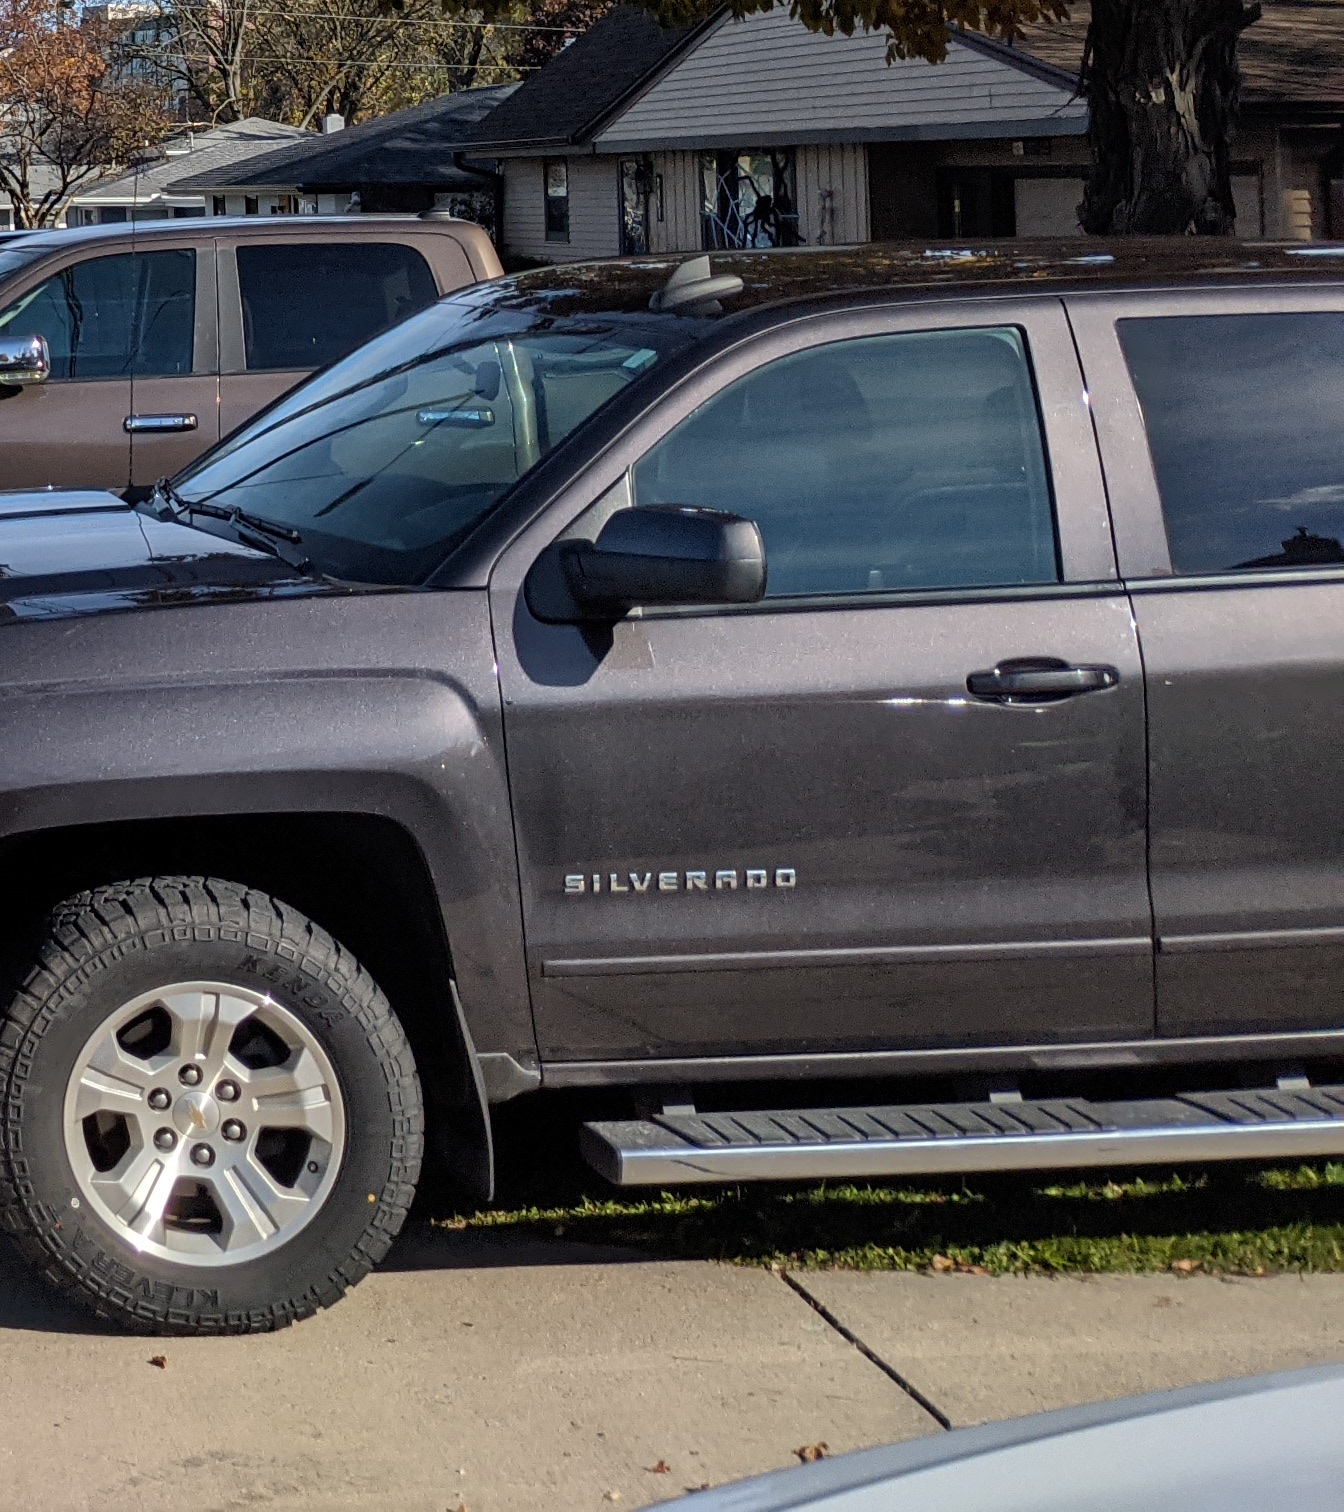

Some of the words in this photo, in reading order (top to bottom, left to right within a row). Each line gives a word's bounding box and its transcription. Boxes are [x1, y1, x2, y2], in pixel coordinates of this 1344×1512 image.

[564, 868, 797, 893] SILVERADO
[237, 954, 344, 1027] KENDA
[91, 1251, 219, 1308] KLEVER
